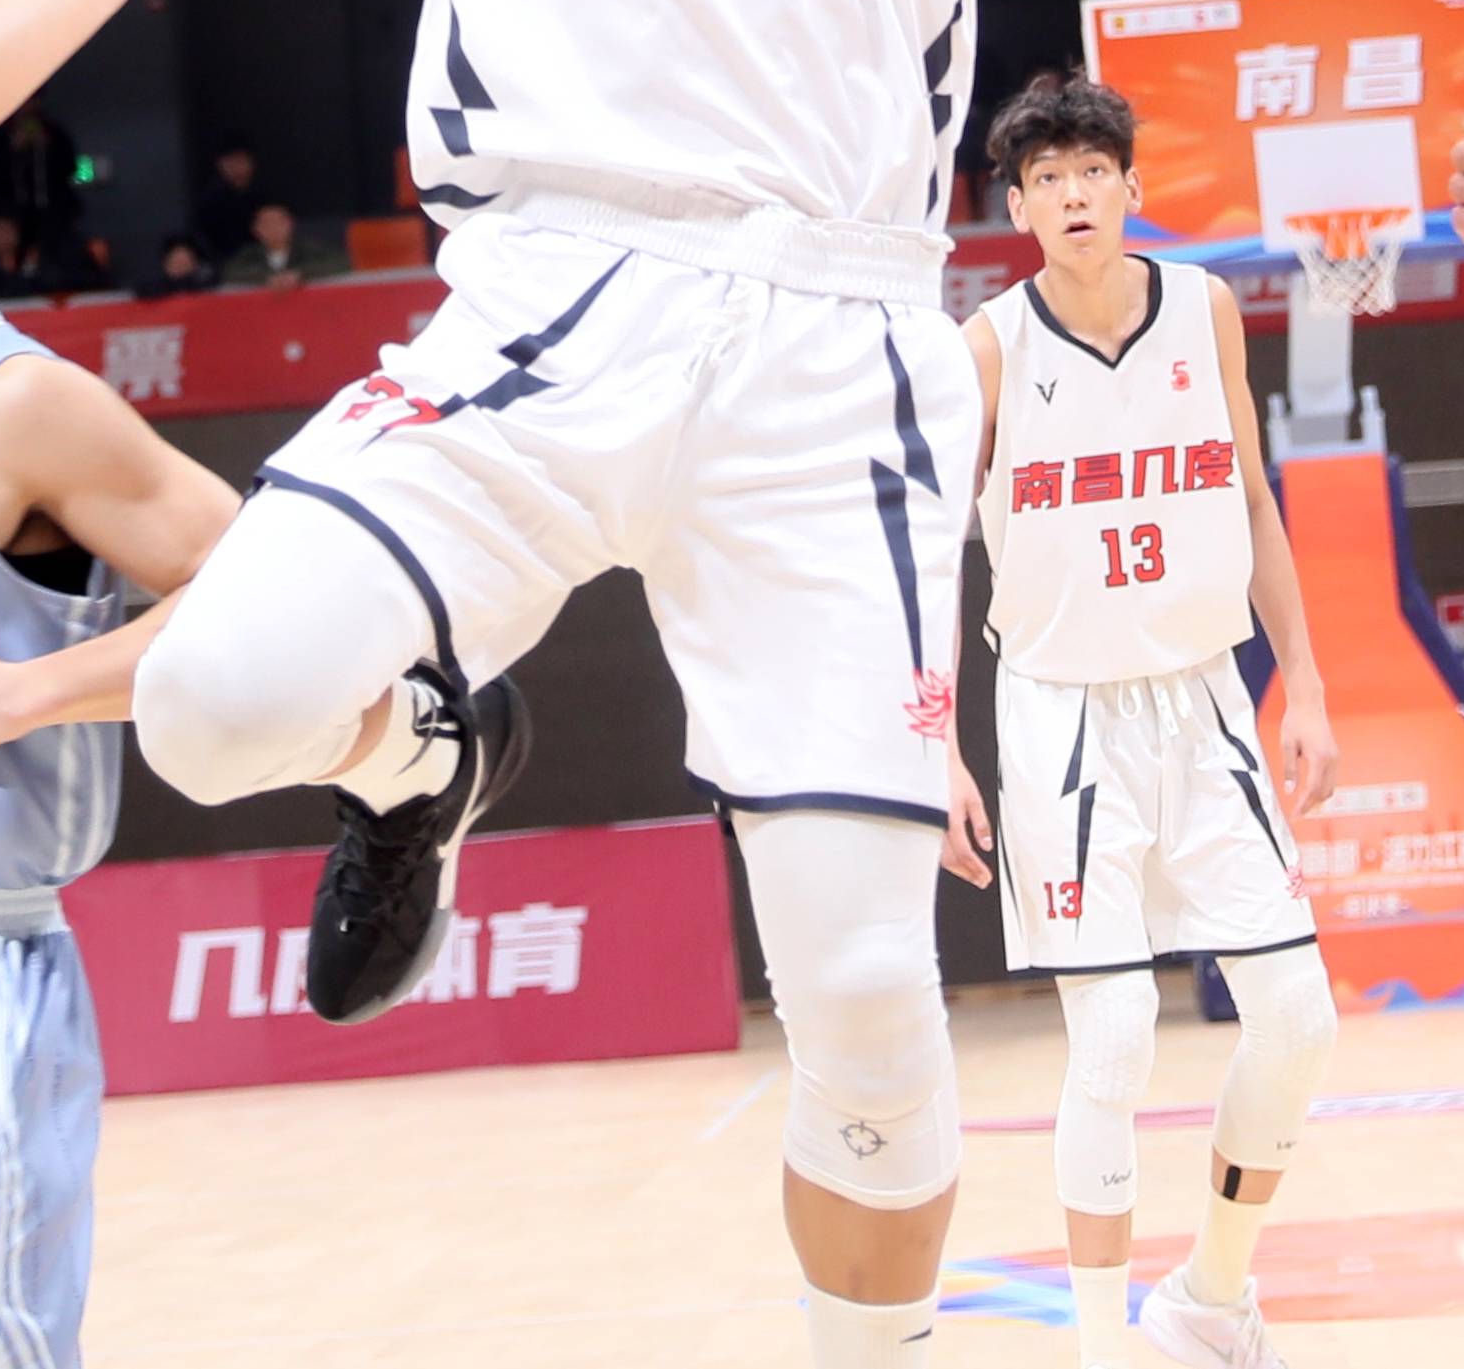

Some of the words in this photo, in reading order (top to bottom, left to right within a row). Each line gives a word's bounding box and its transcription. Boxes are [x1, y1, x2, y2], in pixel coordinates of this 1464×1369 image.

[1235, 33, 1424, 121] 南昌
[1011, 438, 1236, 515] 南昌几度
[1100, 522, 1167, 588] 13
[1042, 878, 1084, 922] 13
[168, 902, 589, 1023] 几体育
